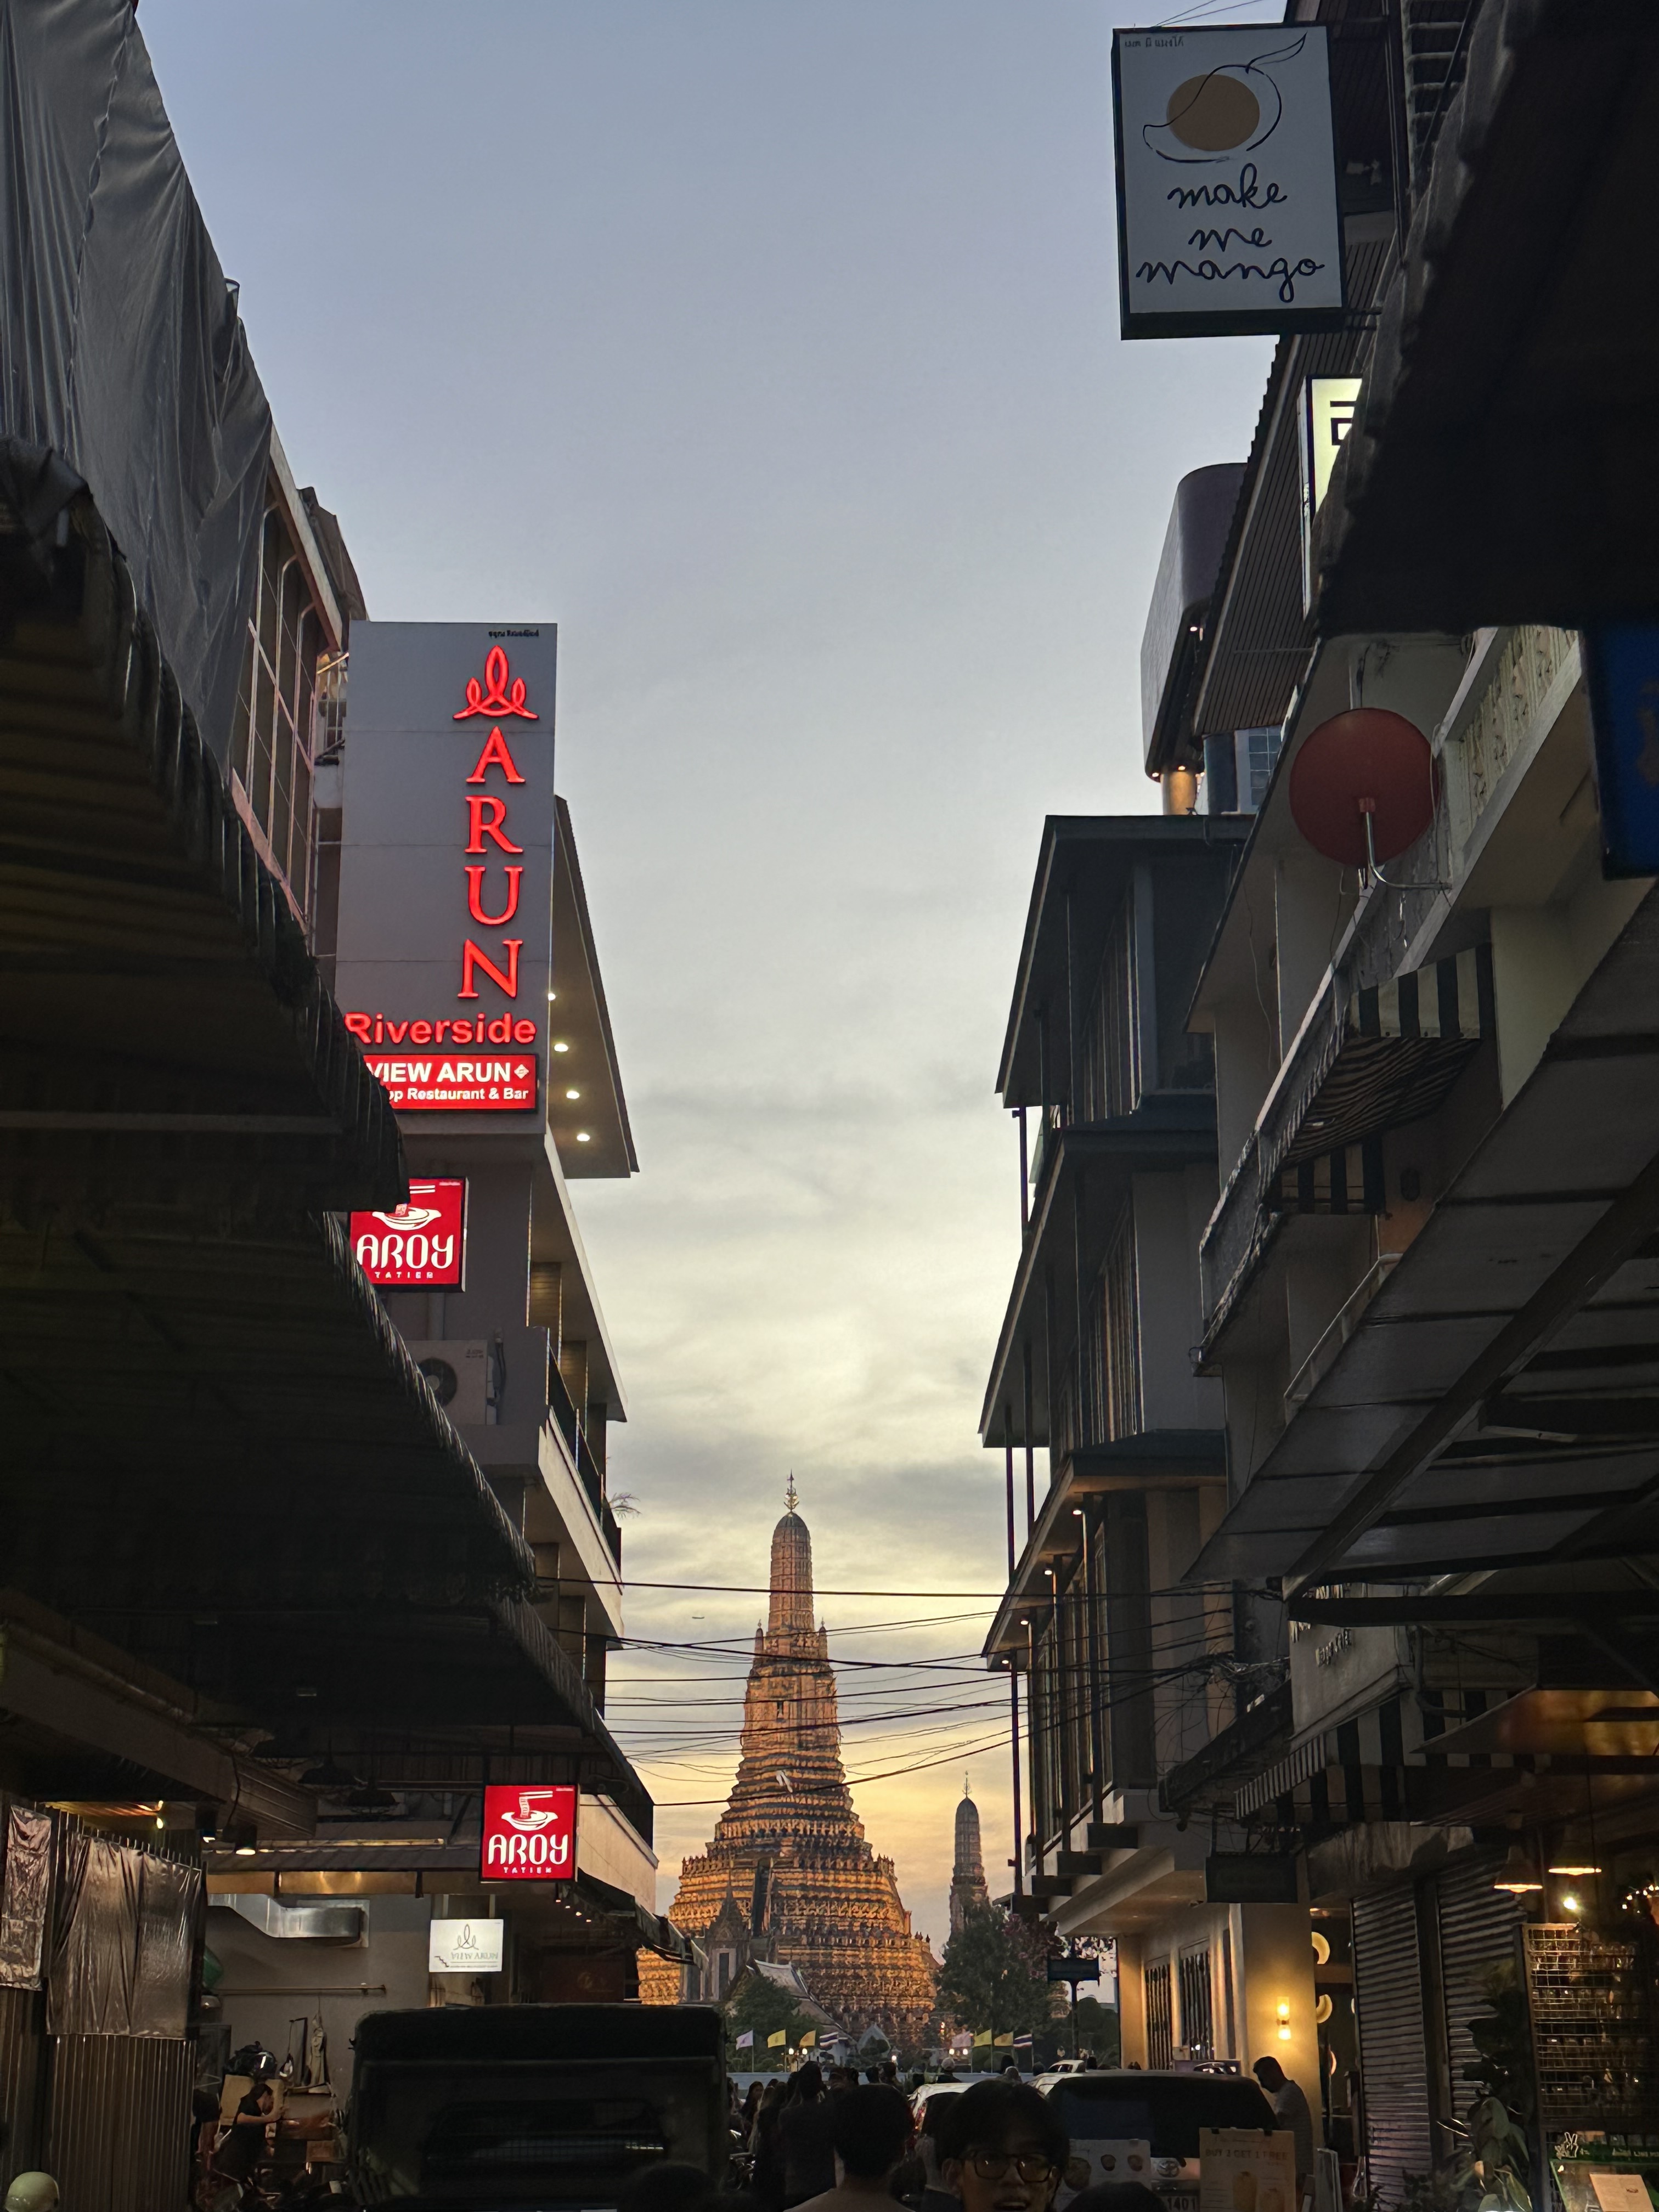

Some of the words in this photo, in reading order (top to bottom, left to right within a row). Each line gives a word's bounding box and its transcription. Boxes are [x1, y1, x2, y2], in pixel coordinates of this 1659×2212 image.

[1167, 162, 1288, 209] make
[1188, 227, 1272, 252] me
[1135, 257, 1325, 303] mango
[457, 725, 526, 999] ARUN
[344, 1012, 537, 1045] Riverside
[366, 1062, 432, 1083] VIEW
[437, 1062, 511, 1083] ARUN
[407, 1087, 486, 1101] Restaurant
[488, 1087, 499, 1100] &
[503, 1088, 529, 1100] Bar
[357, 1234, 454, 1269] AROY
[488, 1833, 569, 1865] AROY
[1205, 2148, 1223, 2157] BUY
[1233, 2149, 1252, 2159] GET
[1256, 2150, 1260, 2159] 1
[1263, 2150, 1288, 2160] FREE
